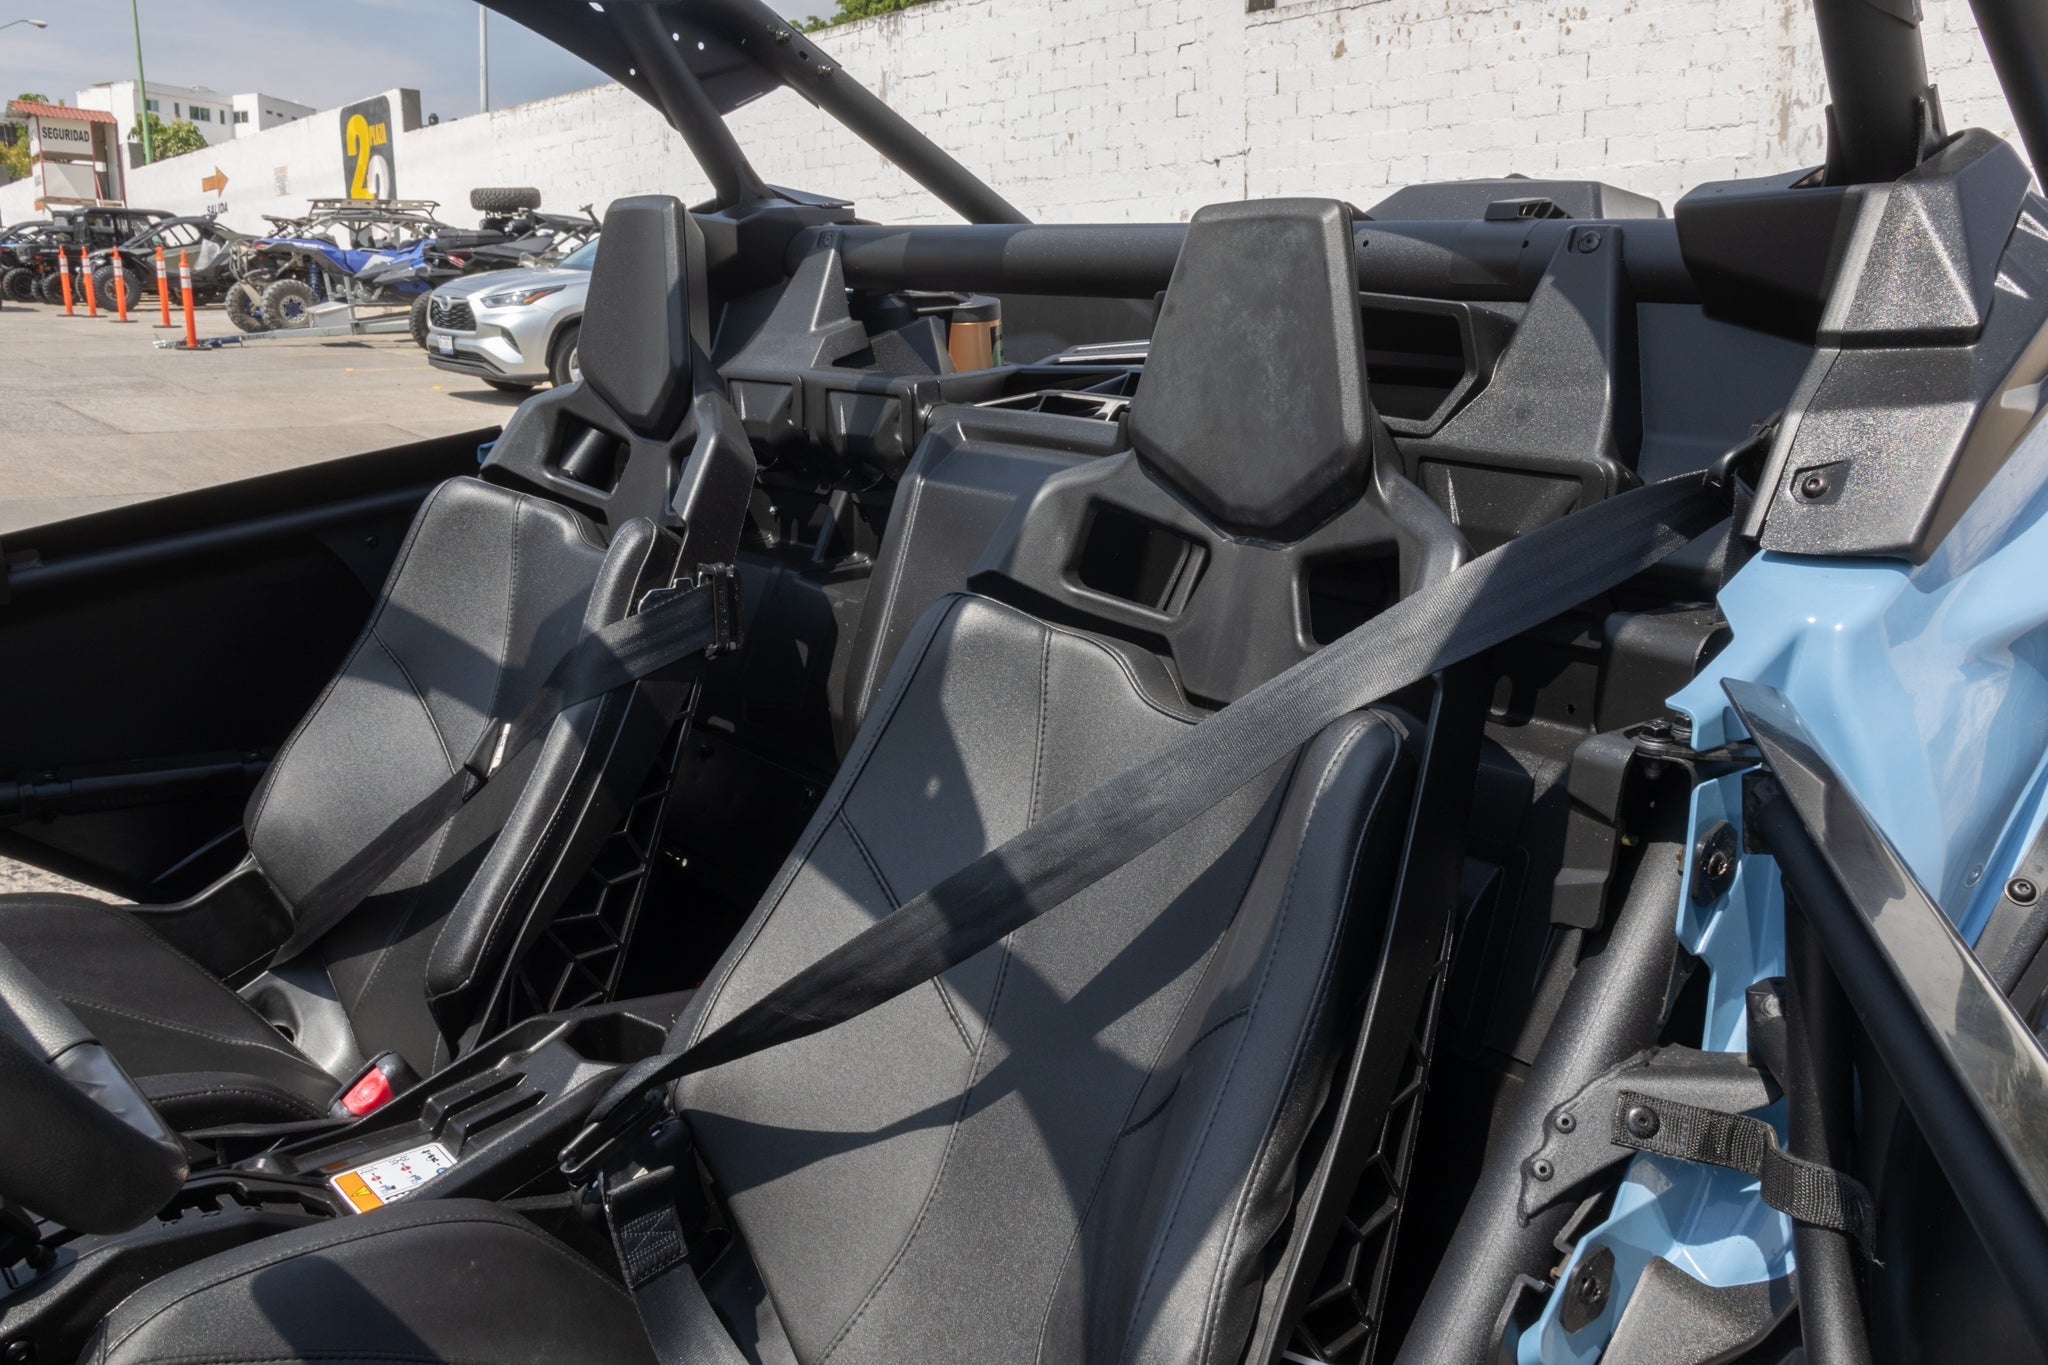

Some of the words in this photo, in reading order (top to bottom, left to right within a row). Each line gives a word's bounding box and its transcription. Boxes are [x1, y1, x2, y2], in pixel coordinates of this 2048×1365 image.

[42, 126, 90, 142] SEGURIDAD
[369, 122, 387, 146] PLAZA
[207, 201, 228, 215] SALIDA
